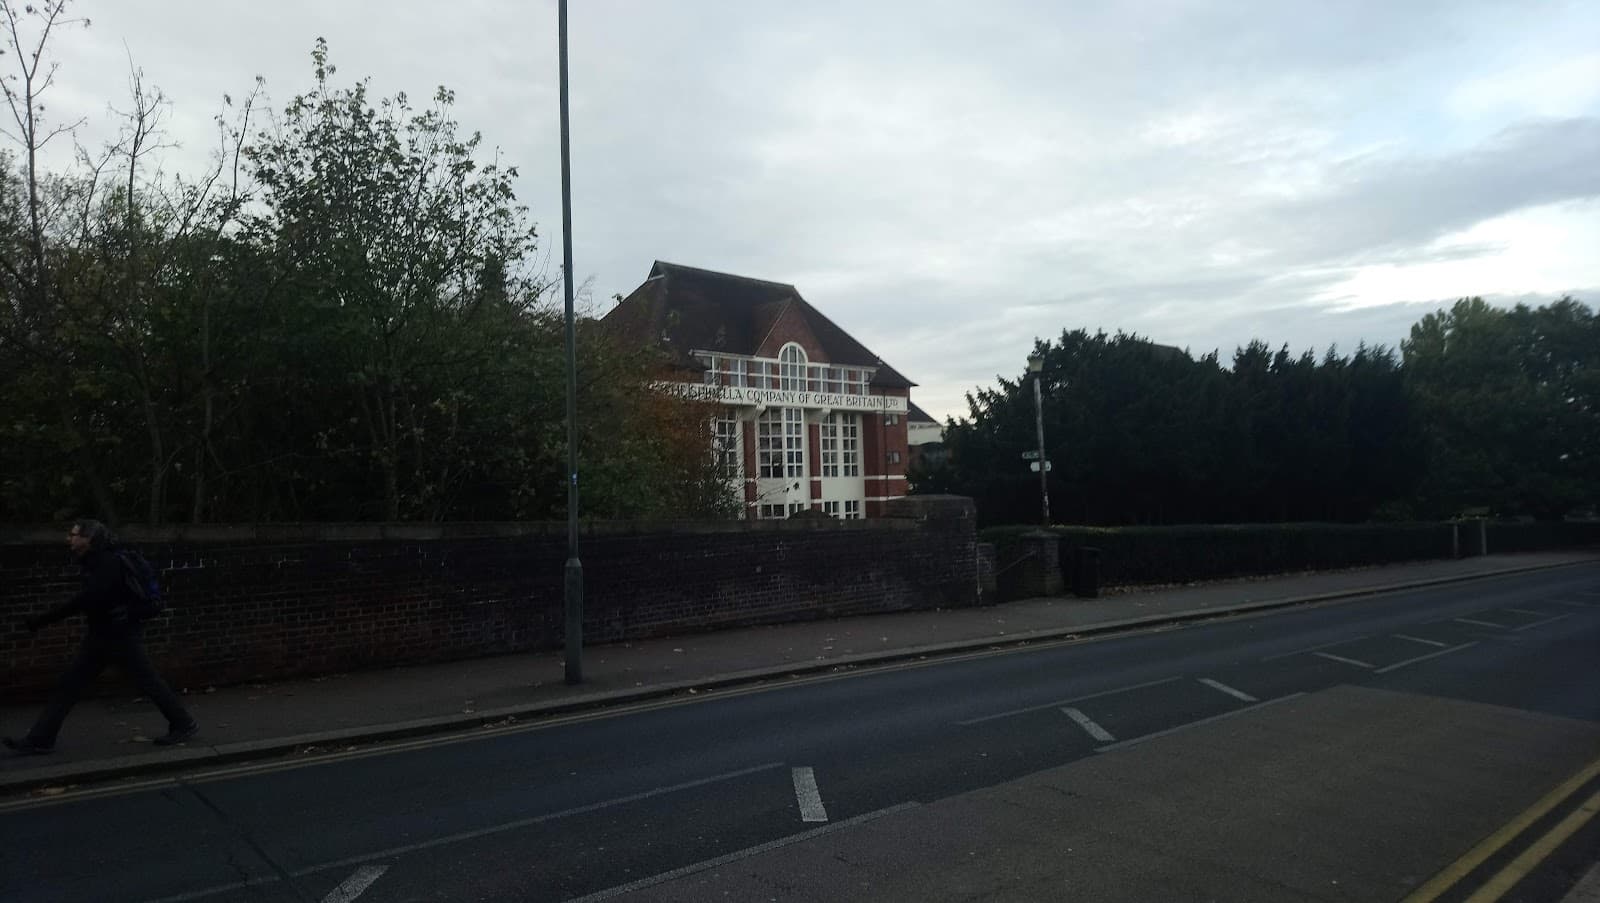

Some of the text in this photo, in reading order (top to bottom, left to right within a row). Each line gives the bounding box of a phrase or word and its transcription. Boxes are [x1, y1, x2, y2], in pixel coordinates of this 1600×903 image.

[746, 389, 795, 404] COMPANY
[798, 392, 810, 405] OF
[814, 393, 843, 407] GREAT
[846, 396, 883, 409] BRITAIN
